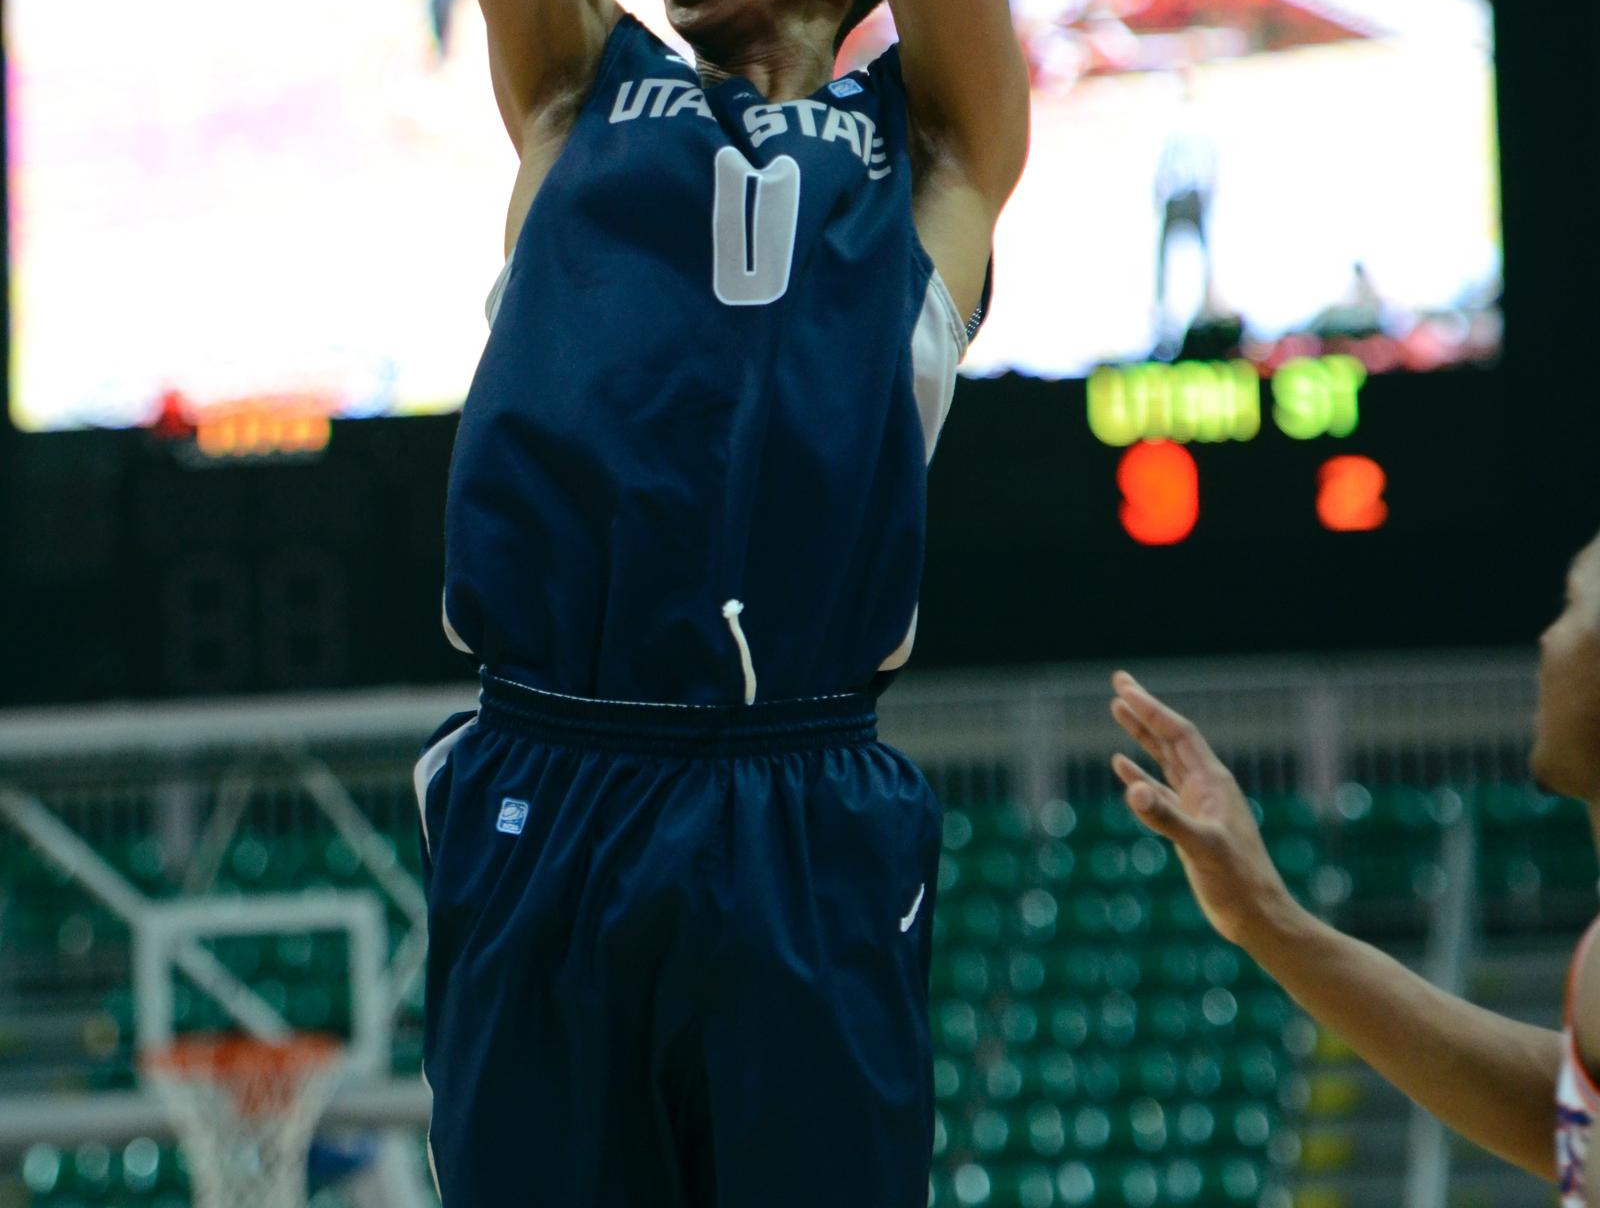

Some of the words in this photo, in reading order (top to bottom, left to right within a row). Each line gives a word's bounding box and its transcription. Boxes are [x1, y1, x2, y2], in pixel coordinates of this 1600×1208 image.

[608, 78, 718, 125] UTA
[742, 98, 893, 181] STATE
[712, 145, 801, 307] 0
